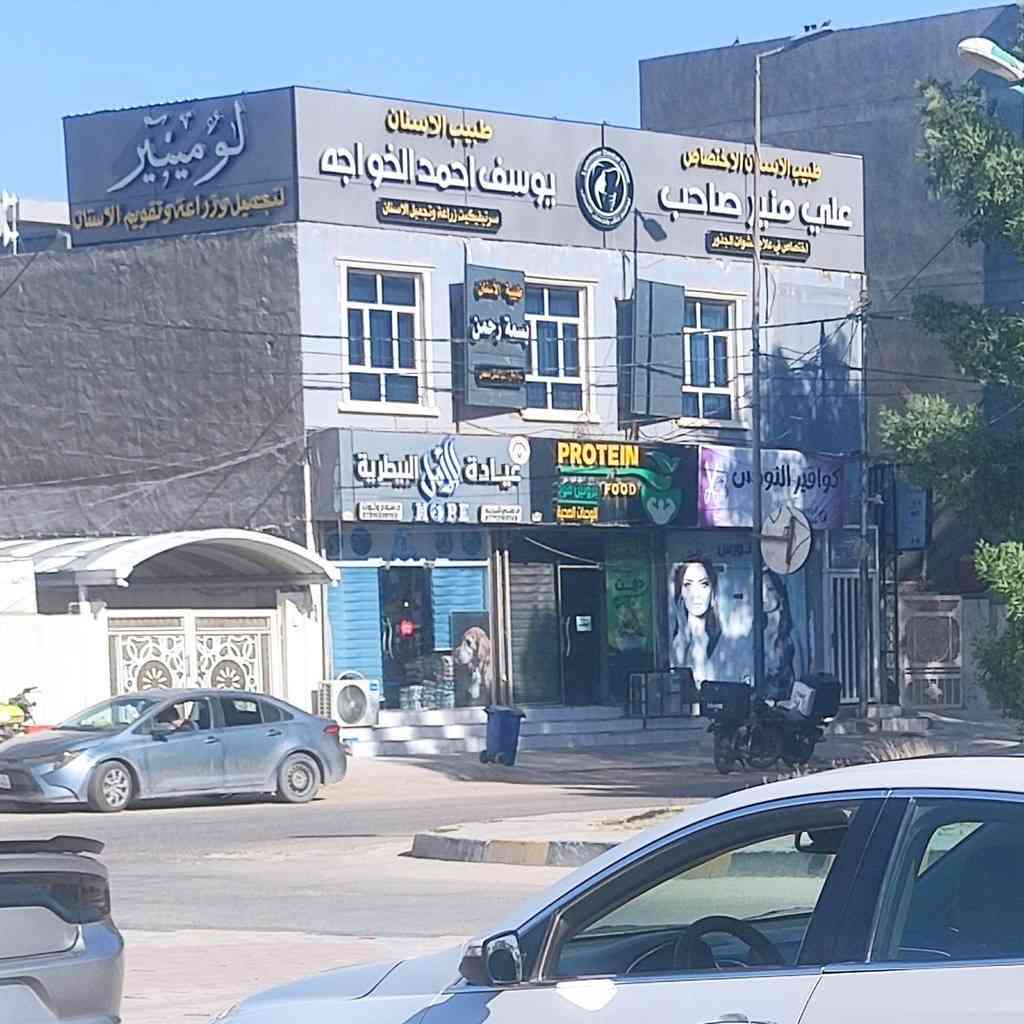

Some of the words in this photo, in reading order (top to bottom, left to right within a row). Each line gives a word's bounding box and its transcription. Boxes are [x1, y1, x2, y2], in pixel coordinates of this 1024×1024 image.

[387, 108, 446, 137] الاسنان
[449, 119, 493, 144] طبيب
[321, 142, 414, 189] الخواجه
[417, 155, 474, 190] احمد
[479, 156, 556, 206] يوسف
[744, 153, 791, 178] الاسن
[792, 161, 822, 185] طبيب
[231, 187, 286, 218] لتجميل
[658, 182, 743, 221] صاحب
[746, 189, 796, 229] منير
[800, 197, 852, 235] علي
[356, 452, 420, 488] البيطرية
[558, 441, 640, 467] PROTEIN
[464, 455, 522, 489] عيادة
[794, 467, 841, 494] كوافير
[603, 483, 638, 497] FOOD
